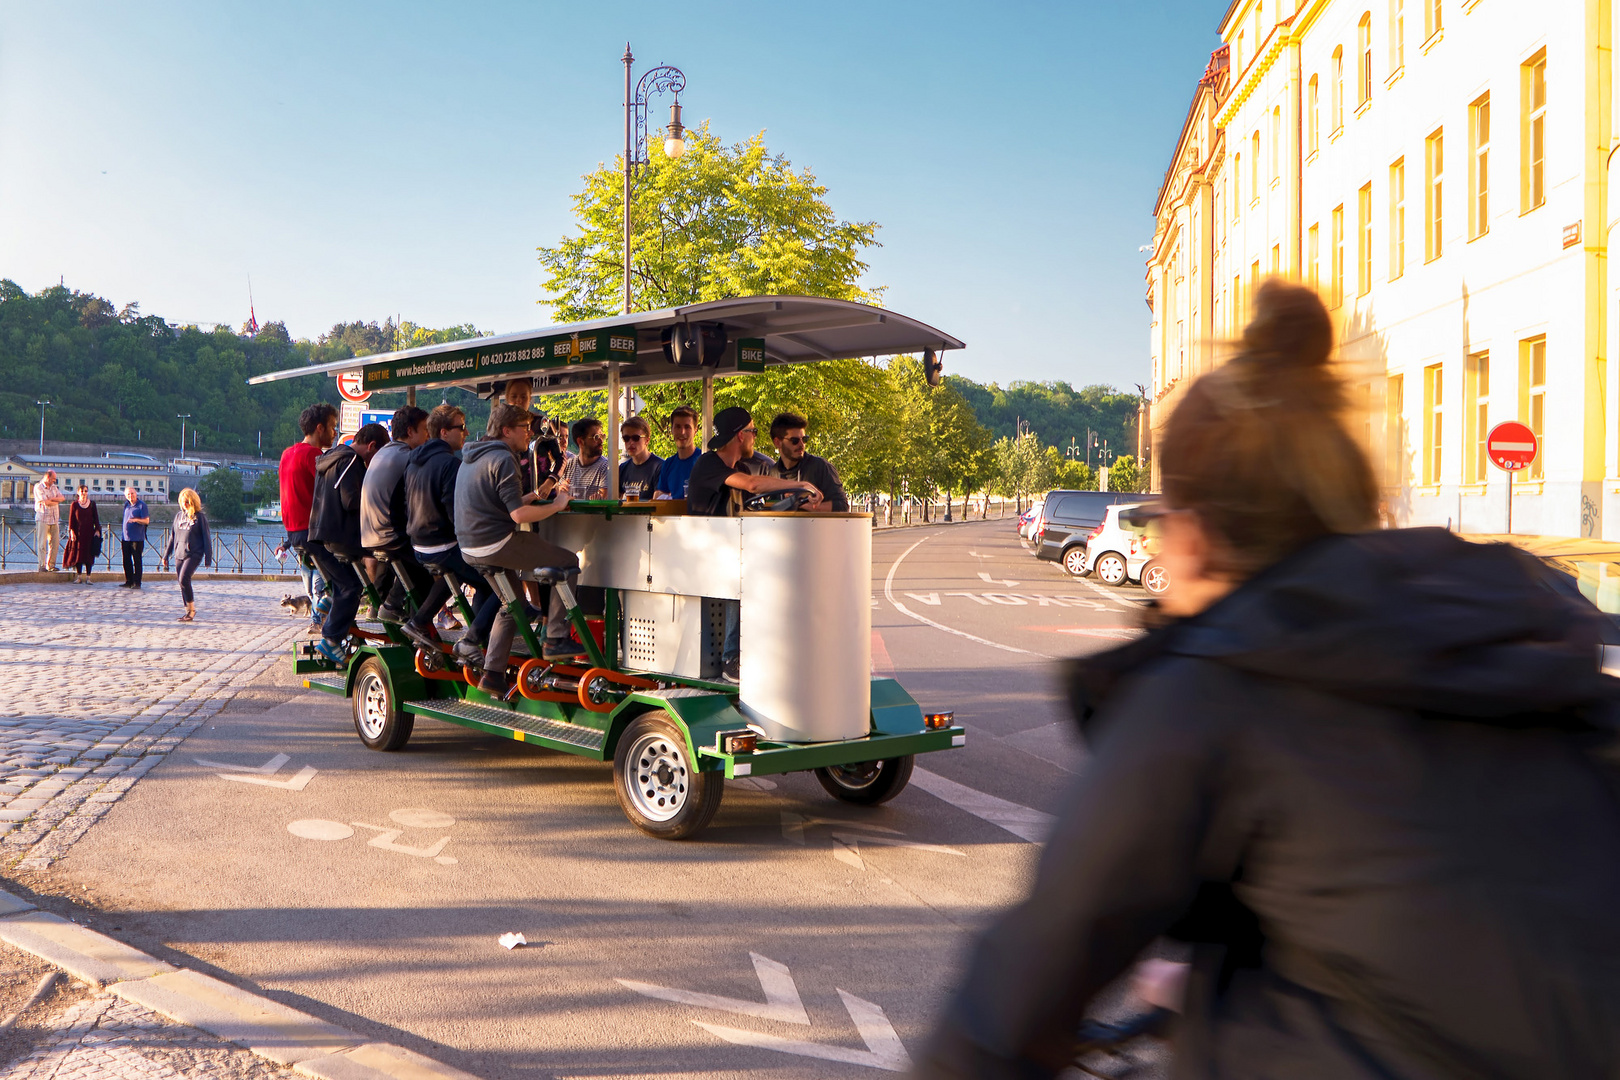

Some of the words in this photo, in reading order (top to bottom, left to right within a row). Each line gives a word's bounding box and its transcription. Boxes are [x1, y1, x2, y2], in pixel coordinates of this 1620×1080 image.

[554, 343, 571, 355] BEER
[579, 339, 597, 352] BIKE
[610, 338, 635, 350] BEER
[741, 350, 763, 361] BIKE
[367, 371, 381, 381] RENT
[381, 369, 390, 379] ME
[396, 358, 474, 377] www.beerbikeprague.cz
[481, 355, 489, 366] 00
[490, 353, 503, 365] 420
[503, 351, 517, 363] 228
[517, 349, 531, 361] 882
[531, 347, 546, 359] 885
